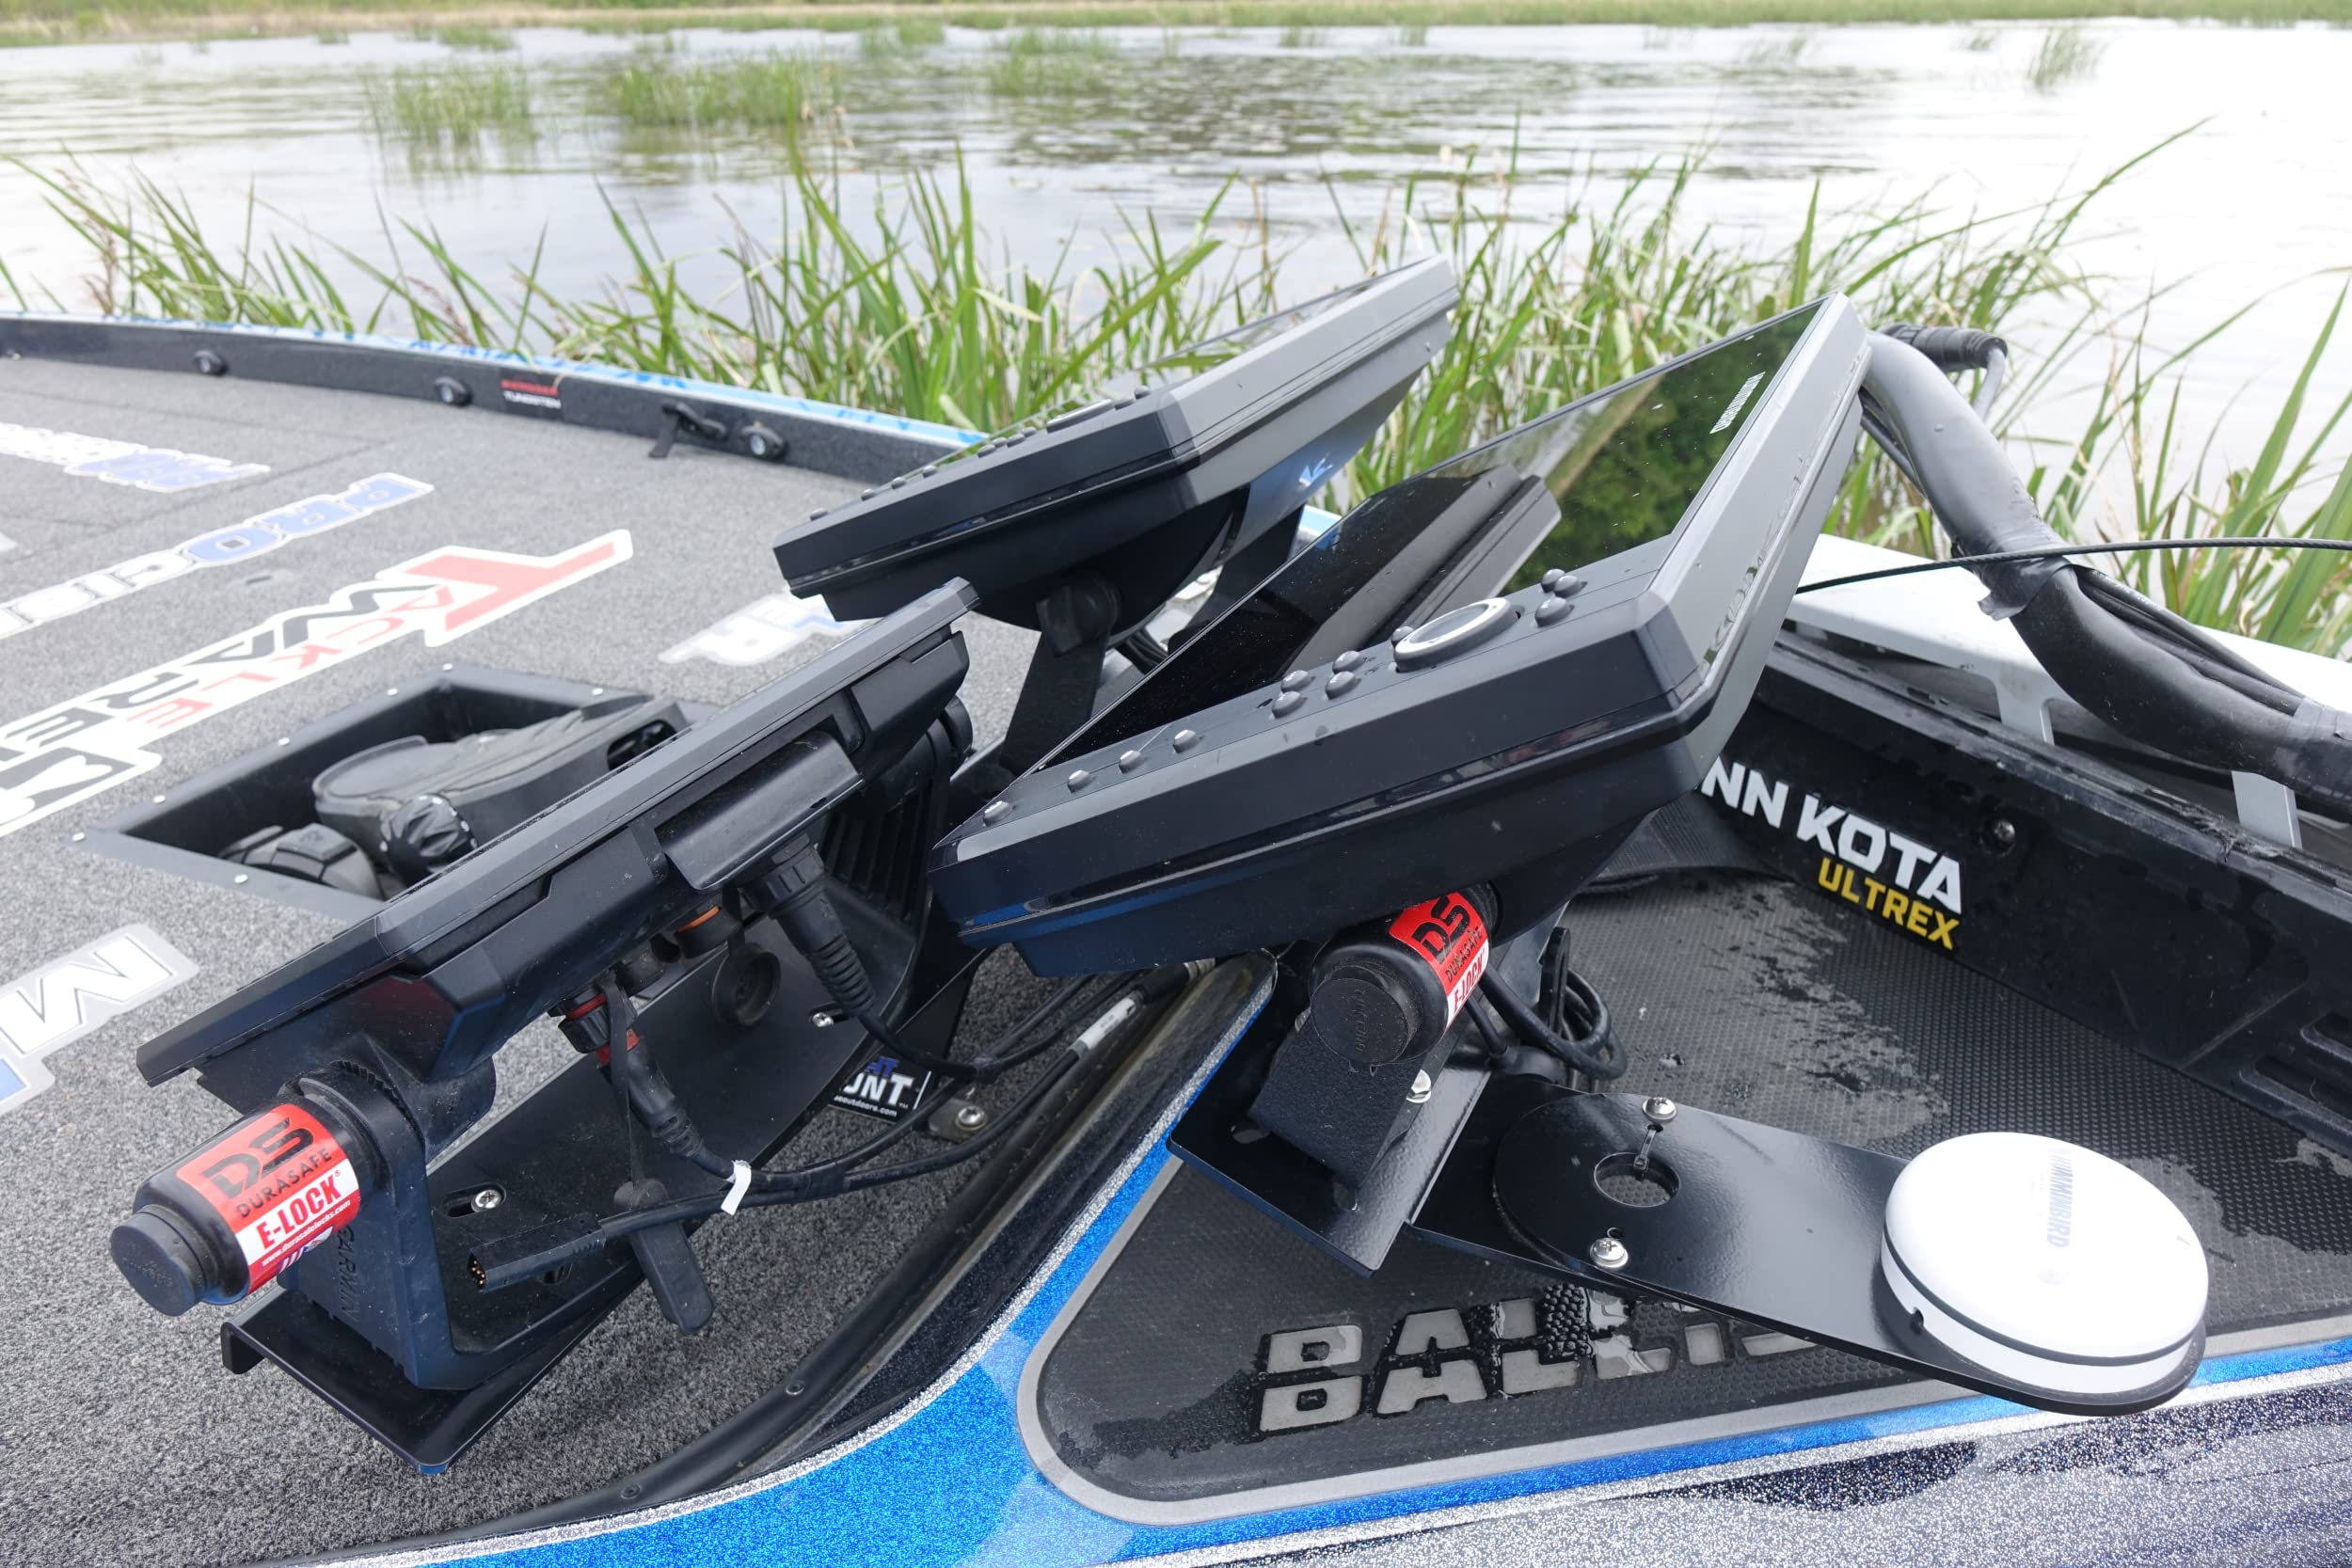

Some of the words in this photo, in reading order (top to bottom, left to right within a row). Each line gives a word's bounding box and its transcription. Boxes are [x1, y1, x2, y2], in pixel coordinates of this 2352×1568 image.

[1796, 794, 1963, 914] KOTA
[1818, 857, 1960, 950] ULTREX
[201, 1117, 314, 1199] DS
[235, 1148, 332, 1218] DURASAFE
[2046, 1153, 2074, 1248] HUMMINBIRD
[338, 1225, 359, 1322] GARMIN
